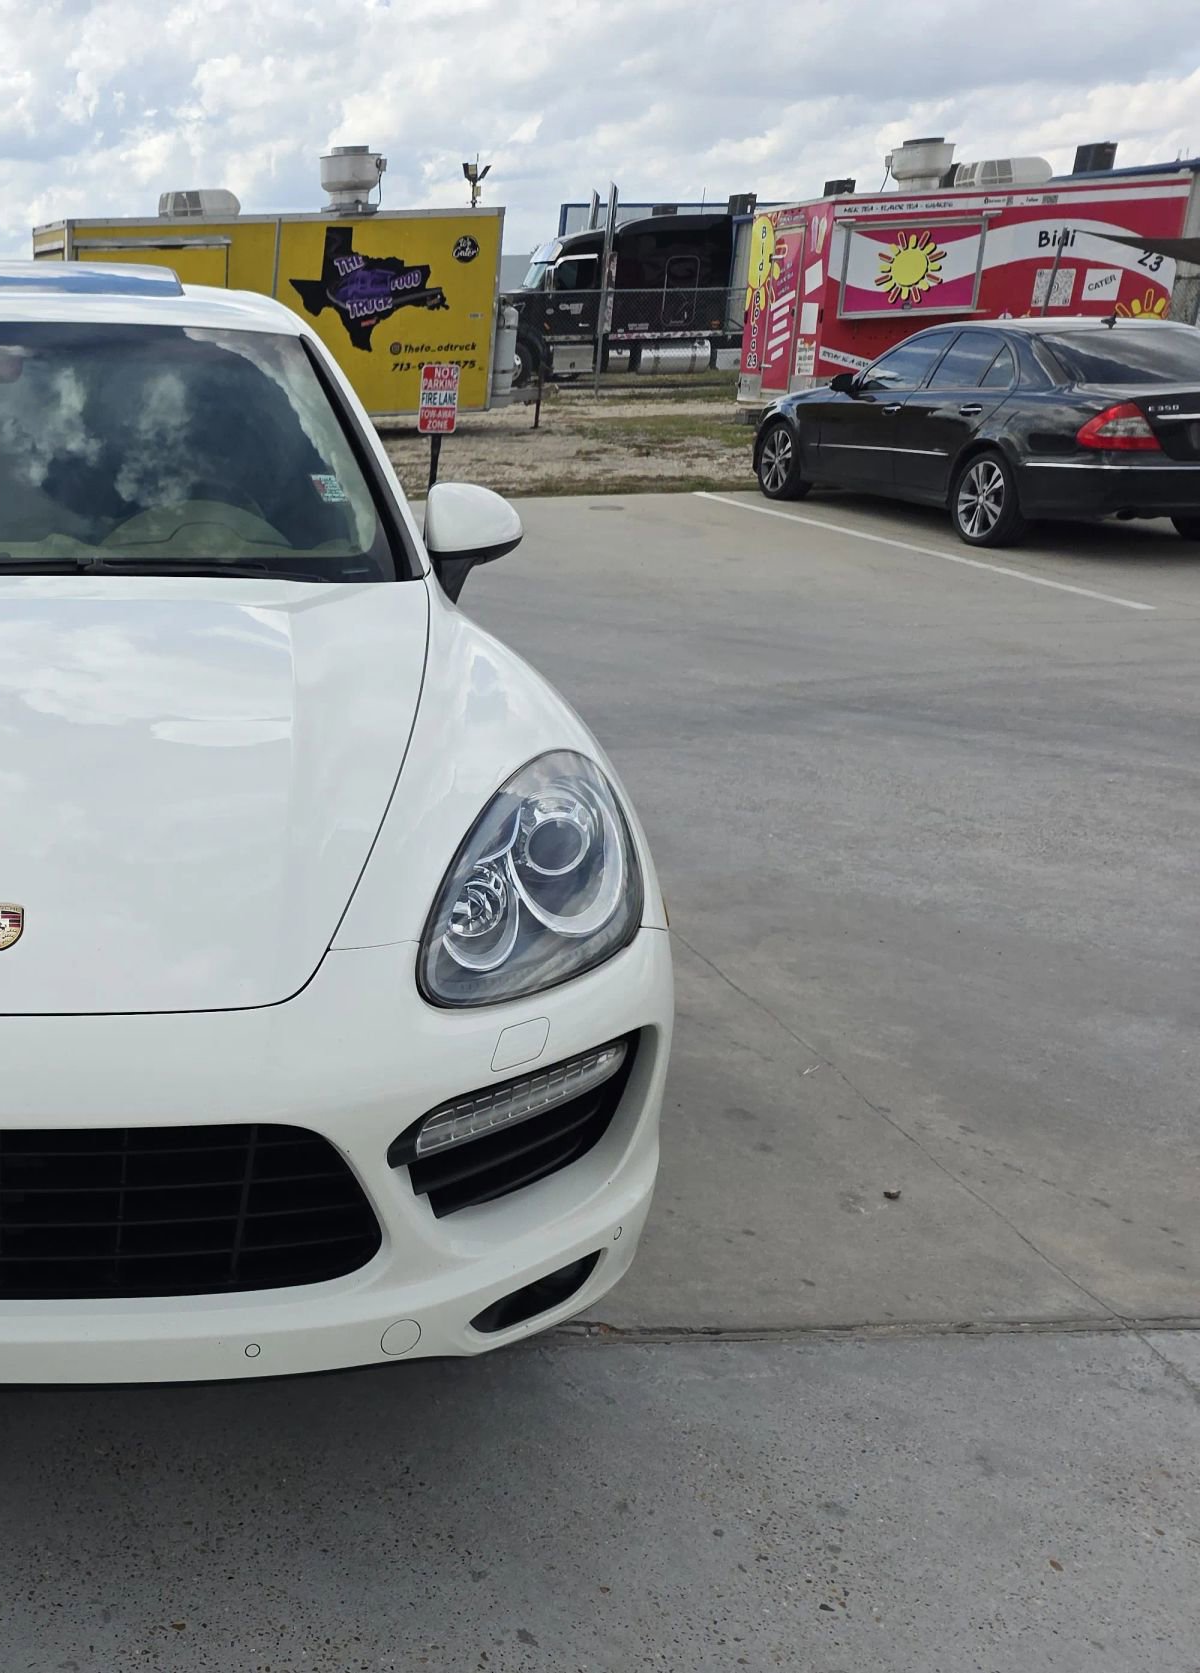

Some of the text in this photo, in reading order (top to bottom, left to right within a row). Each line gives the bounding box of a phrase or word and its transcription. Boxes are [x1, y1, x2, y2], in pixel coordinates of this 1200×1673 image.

[1038, 229, 1164, 272] Bidi 23
[334, 256, 366, 277] THE
[390, 269, 422, 291] FOOD
[1087, 274, 1117, 291] CATER
[346, 296, 393, 319] TRUCK
[434, 367, 450, 379] NO
[423, 378, 458, 391] PARKING
[421, 392, 457, 406] FIRE LANE
[426, 419, 449, 430] ZONE
